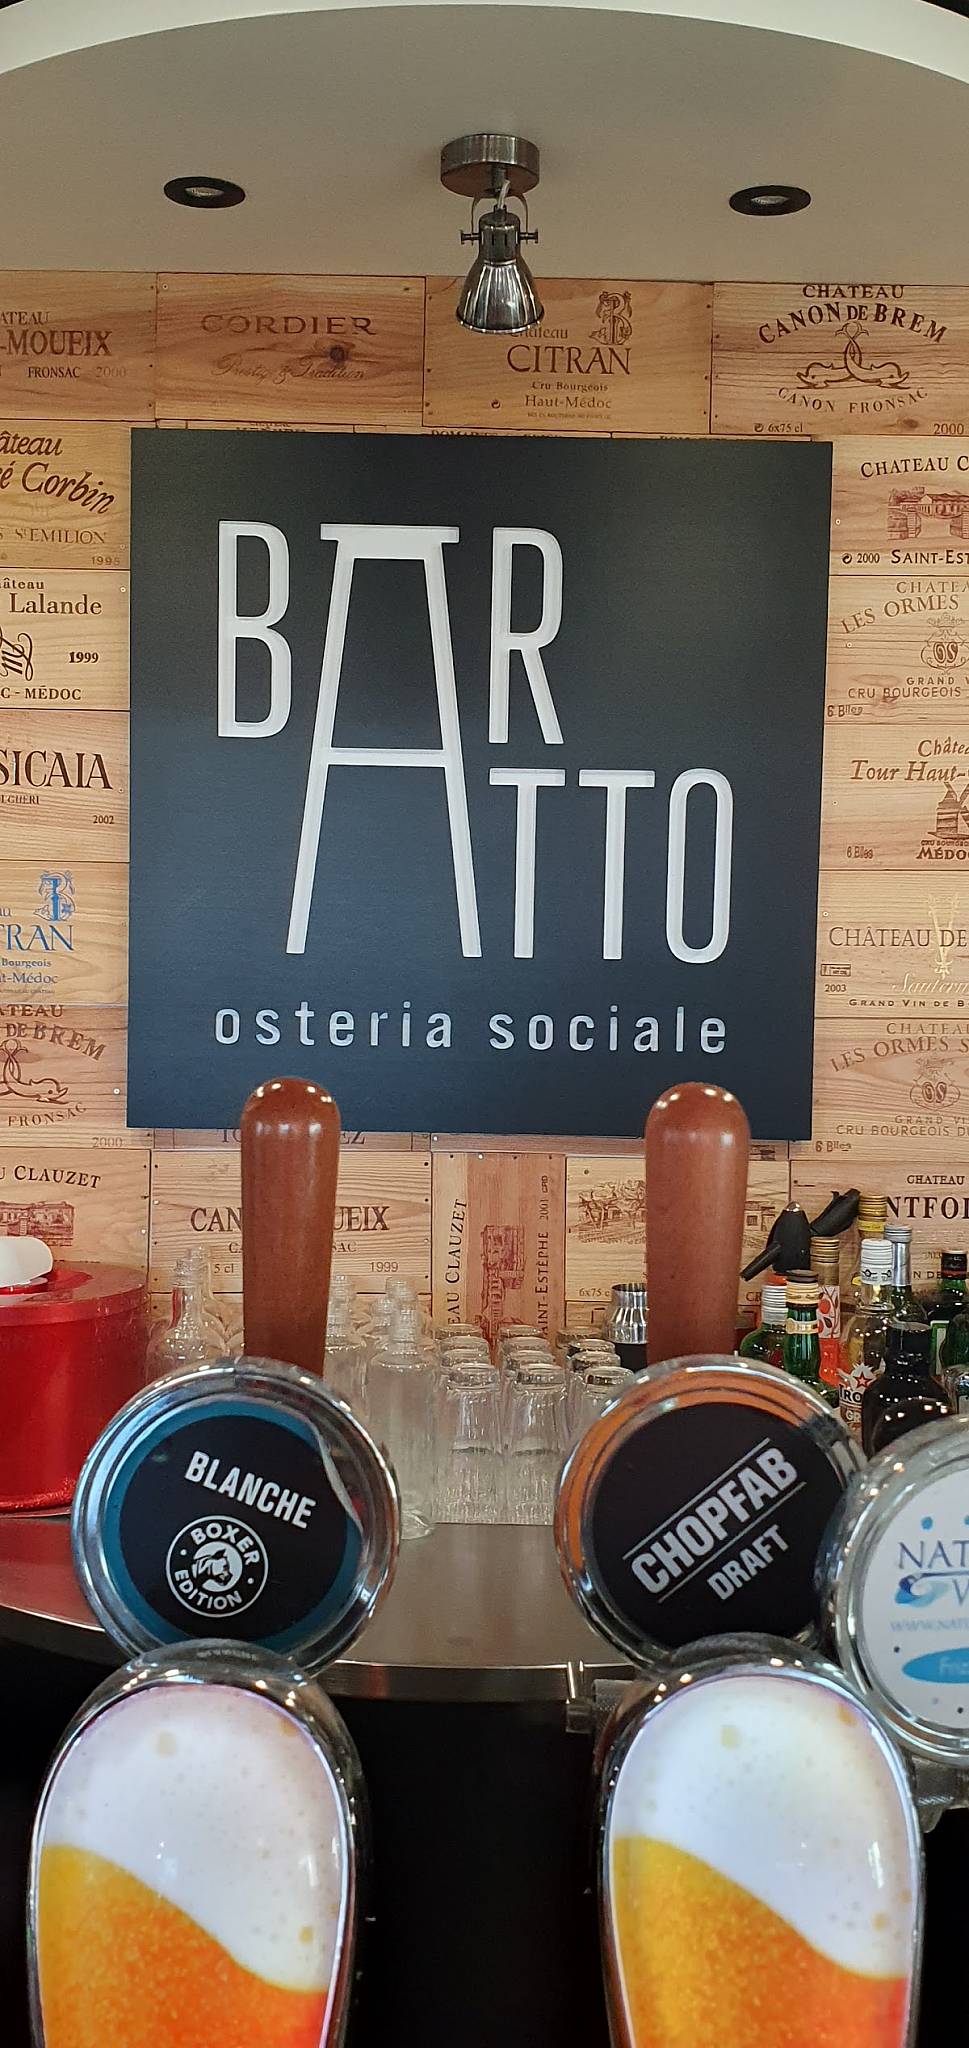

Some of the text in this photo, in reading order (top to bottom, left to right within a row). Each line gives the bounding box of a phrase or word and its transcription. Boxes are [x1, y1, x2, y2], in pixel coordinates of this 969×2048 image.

[803, 284, 904, 299] CHATEAU
[201, 314, 377, 335] CORDIER
[759, 302, 948, 344] CANON DE BREM
[506, 344, 632, 375] CITRAN
[27, 366, 127, 378] FRONSAC 2000
[531, 381, 609, 392] Cru Bourgeois
[524, 395, 612, 409] Haut-Médoc
[778, 386, 928, 414] CANON FRONSAC
[767, 423, 792, 433] 6x75
[933, 422, 965, 436] 2000
[860, 456, 950, 478] CHATEAU
[22, 461, 115, 514] Corbin
[856, 552, 881, 564] 2000
[0, 577, 45, 590] âteau
[9, 592, 102, 615] Lalande
[841, 594, 960, 634] LES ORMES
[68, 651, 99, 664] 1999
[906, 676, 955, 686] GRAND
[25, 684, 82, 701] MÉDOC
[848, 686, 962, 699] CRU BOURGEOIS
[827, 704, 836, 717] 6
[850, 759, 969, 782] Tour Haut-
[92, 815, 114, 825] 2002
[916, 848, 969, 861] MÉDO
[828, 924, 968, 948] CHÂTEAU DE
[2, 958, 52, 968] Bourgeois
[0, 971, 59, 984] t-Médoc
[824, 983, 847, 993] 2003
[848, 998, 895, 1007] GRAND
[902, 999, 926, 1007] VIN
[957, 999, 969, 1007] B
[213, 1001, 728, 1054] osteria sociale
[6, 1020, 107, 1061] DE BREM
[830, 1047, 866, 1072] LES
[873, 1035, 949, 1057] ORMES
[8, 1101, 87, 1128] FRONSAC
[894, 1115, 943, 1125] GRAND
[836, 1124, 864, 1135] CRU
[870, 1125, 950, 1137] BOURGEOIS
[92, 1137, 123, 1148] 2000
[815, 1140, 823, 1152] 6
[14, 1165, 101, 1188] CLAUZET
[906, 1174, 966, 1185] CHATEAU
[538, 1199, 549, 1221] 2001
[445, 1199, 468, 1284] CLAUZET
[369, 1261, 399, 1273] 1999
[579, 1287, 603, 1297] 6x75
[184, 1450, 317, 1529] BLANCHE
[631, 1447, 798, 1594] CHOPFAB
[190, 1522, 261, 1566] BOXER
[898, 1539, 969, 1569] NAT
[706, 1523, 789, 1601] DRAFT
[174, 1568, 243, 1611] EDITION
